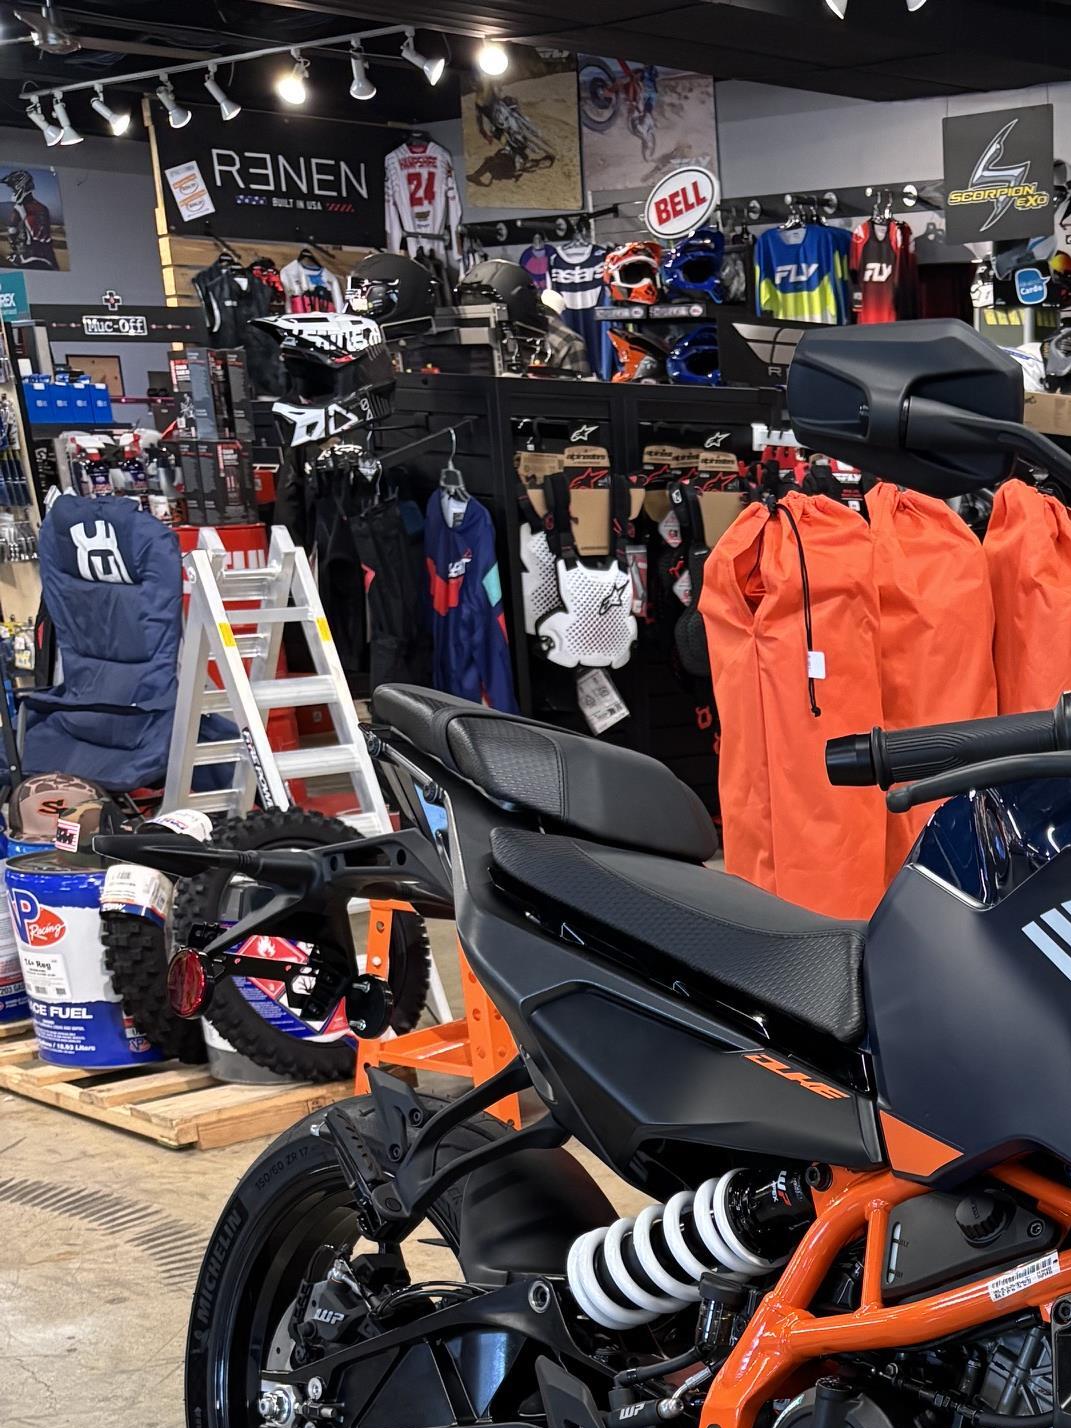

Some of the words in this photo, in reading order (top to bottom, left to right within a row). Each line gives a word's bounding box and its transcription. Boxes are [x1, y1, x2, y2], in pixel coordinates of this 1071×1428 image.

[272, 197, 293, 208] BUILT
[296, 200, 305, 209] IN
[306, 201, 322, 211] USA
[653, 180, 708, 226] BELL
[948, 183, 1037, 205] SCORPION
[774, 262, 819, 285] FLY
[863, 262, 893, 283] FLY
[87, 318, 145, 333] Muc-Off
[29, 922, 66, 941] Racing
[50, 1006, 93, 1020] FUEL
[744, 1054, 851, 1099] DUKE
[196, 1208, 243, 1324] MICHELIN
[313, 1308, 345, 1325] WP
[619, 1402, 646, 1421] WP
